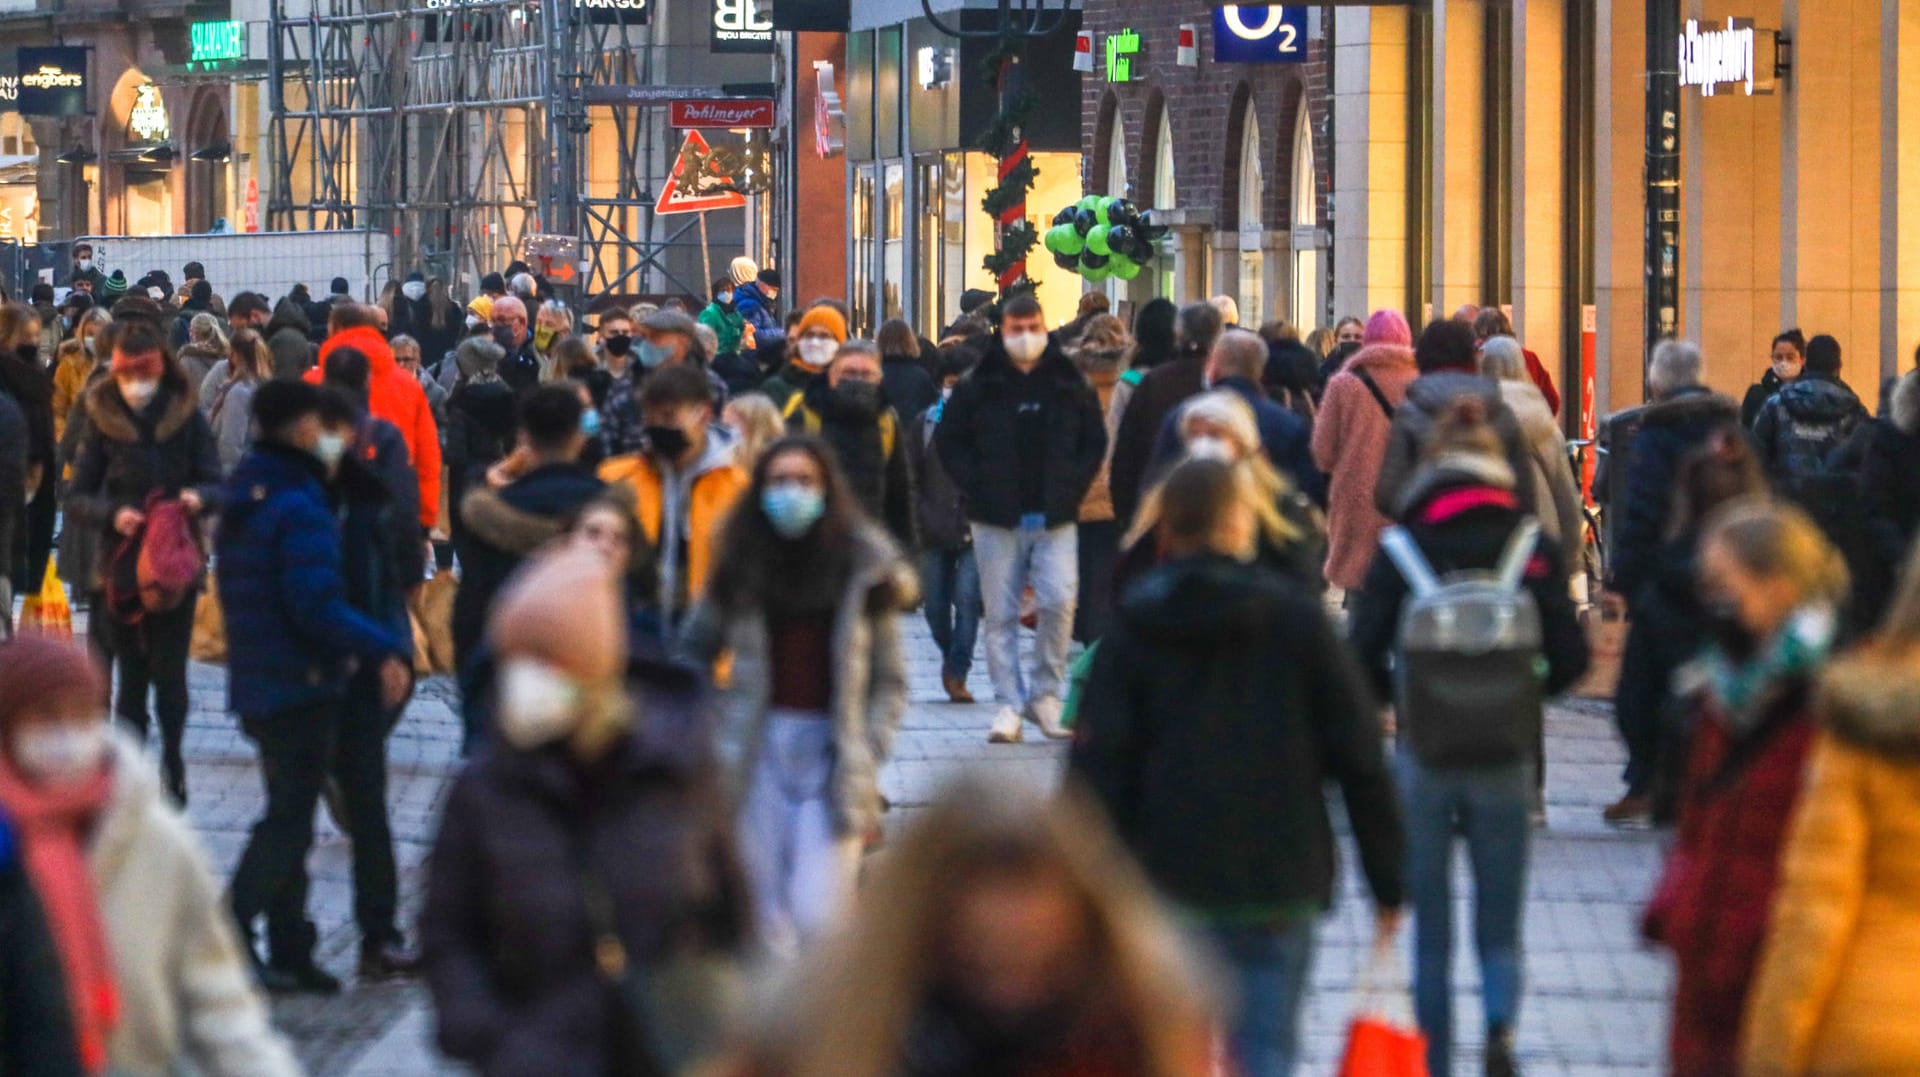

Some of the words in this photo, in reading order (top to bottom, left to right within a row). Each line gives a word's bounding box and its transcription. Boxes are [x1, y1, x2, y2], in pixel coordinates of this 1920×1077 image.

[716, 31, 739, 40] BIJOU
[22, 73, 82, 90] engbers
[684, 104, 766, 124] Pohlmeyer
